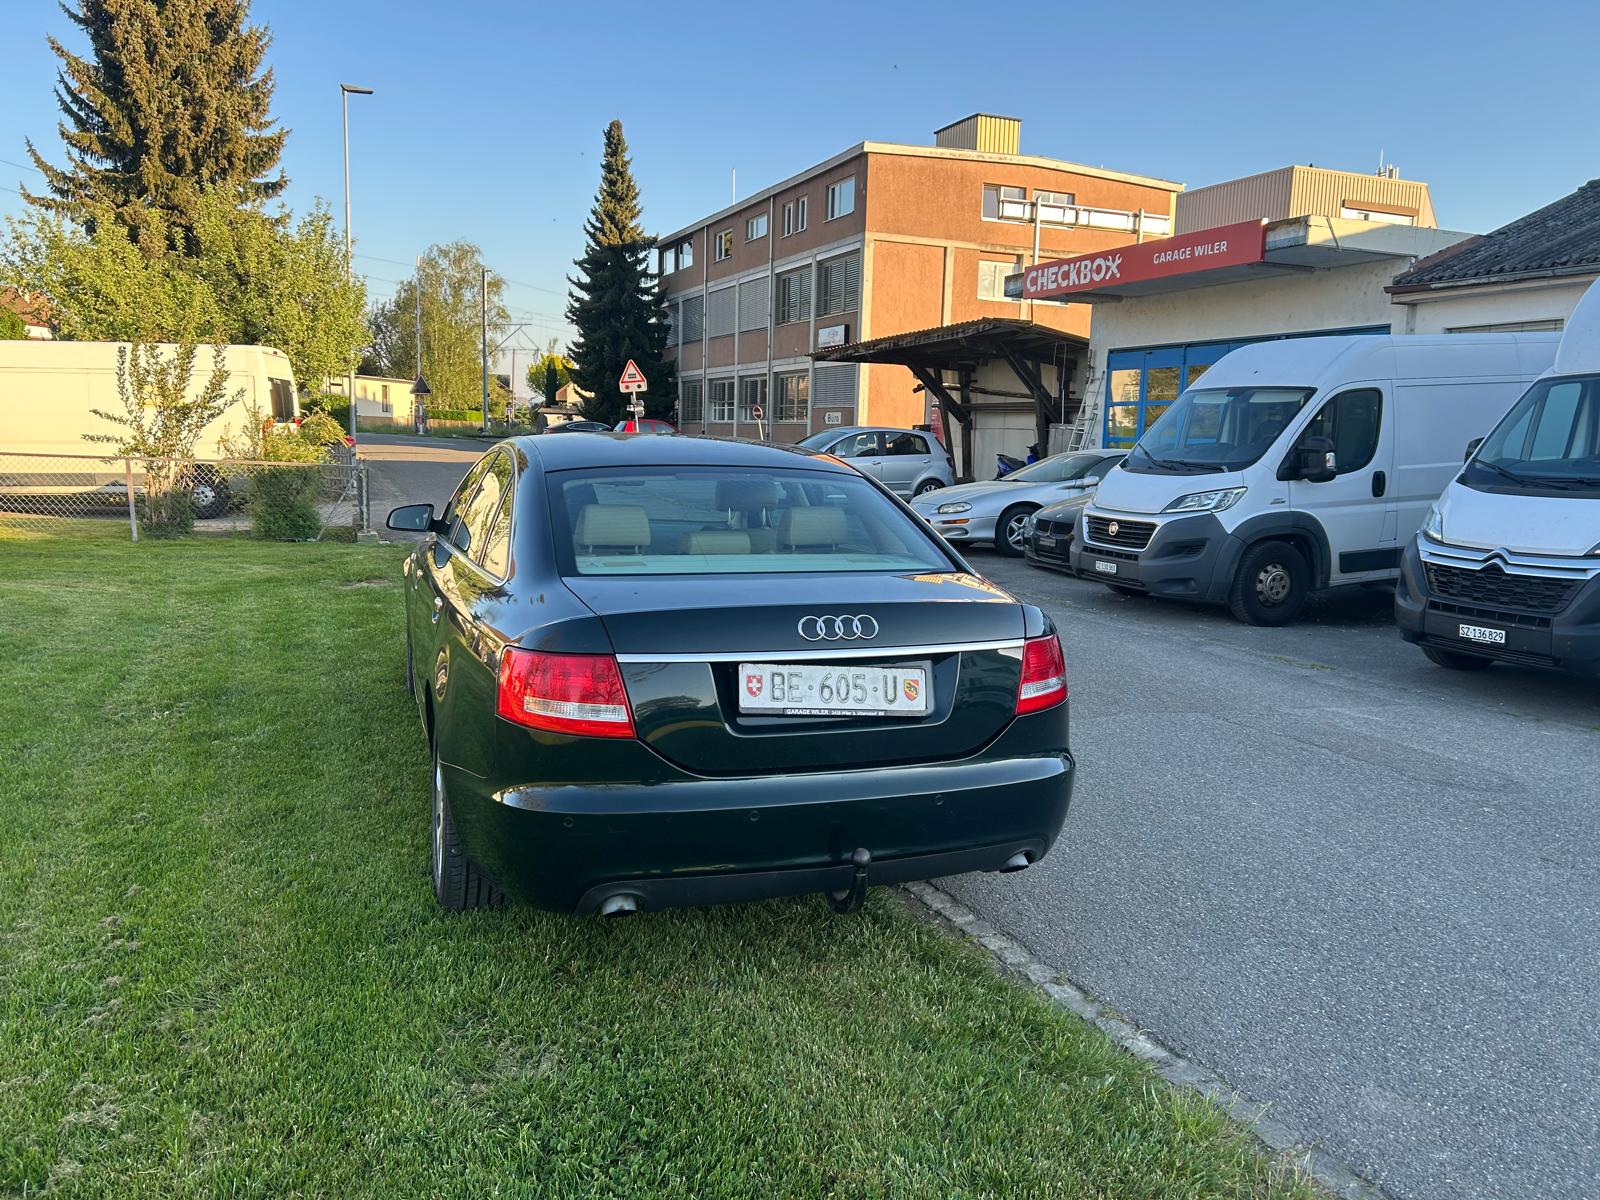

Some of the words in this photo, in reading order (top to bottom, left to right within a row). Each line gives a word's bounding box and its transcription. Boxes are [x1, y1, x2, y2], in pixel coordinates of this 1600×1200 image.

[1026, 253, 1123, 292] CHECKBOX
[1153, 247, 1191, 264] GARAGE
[1194, 240, 1228, 257] WILER
